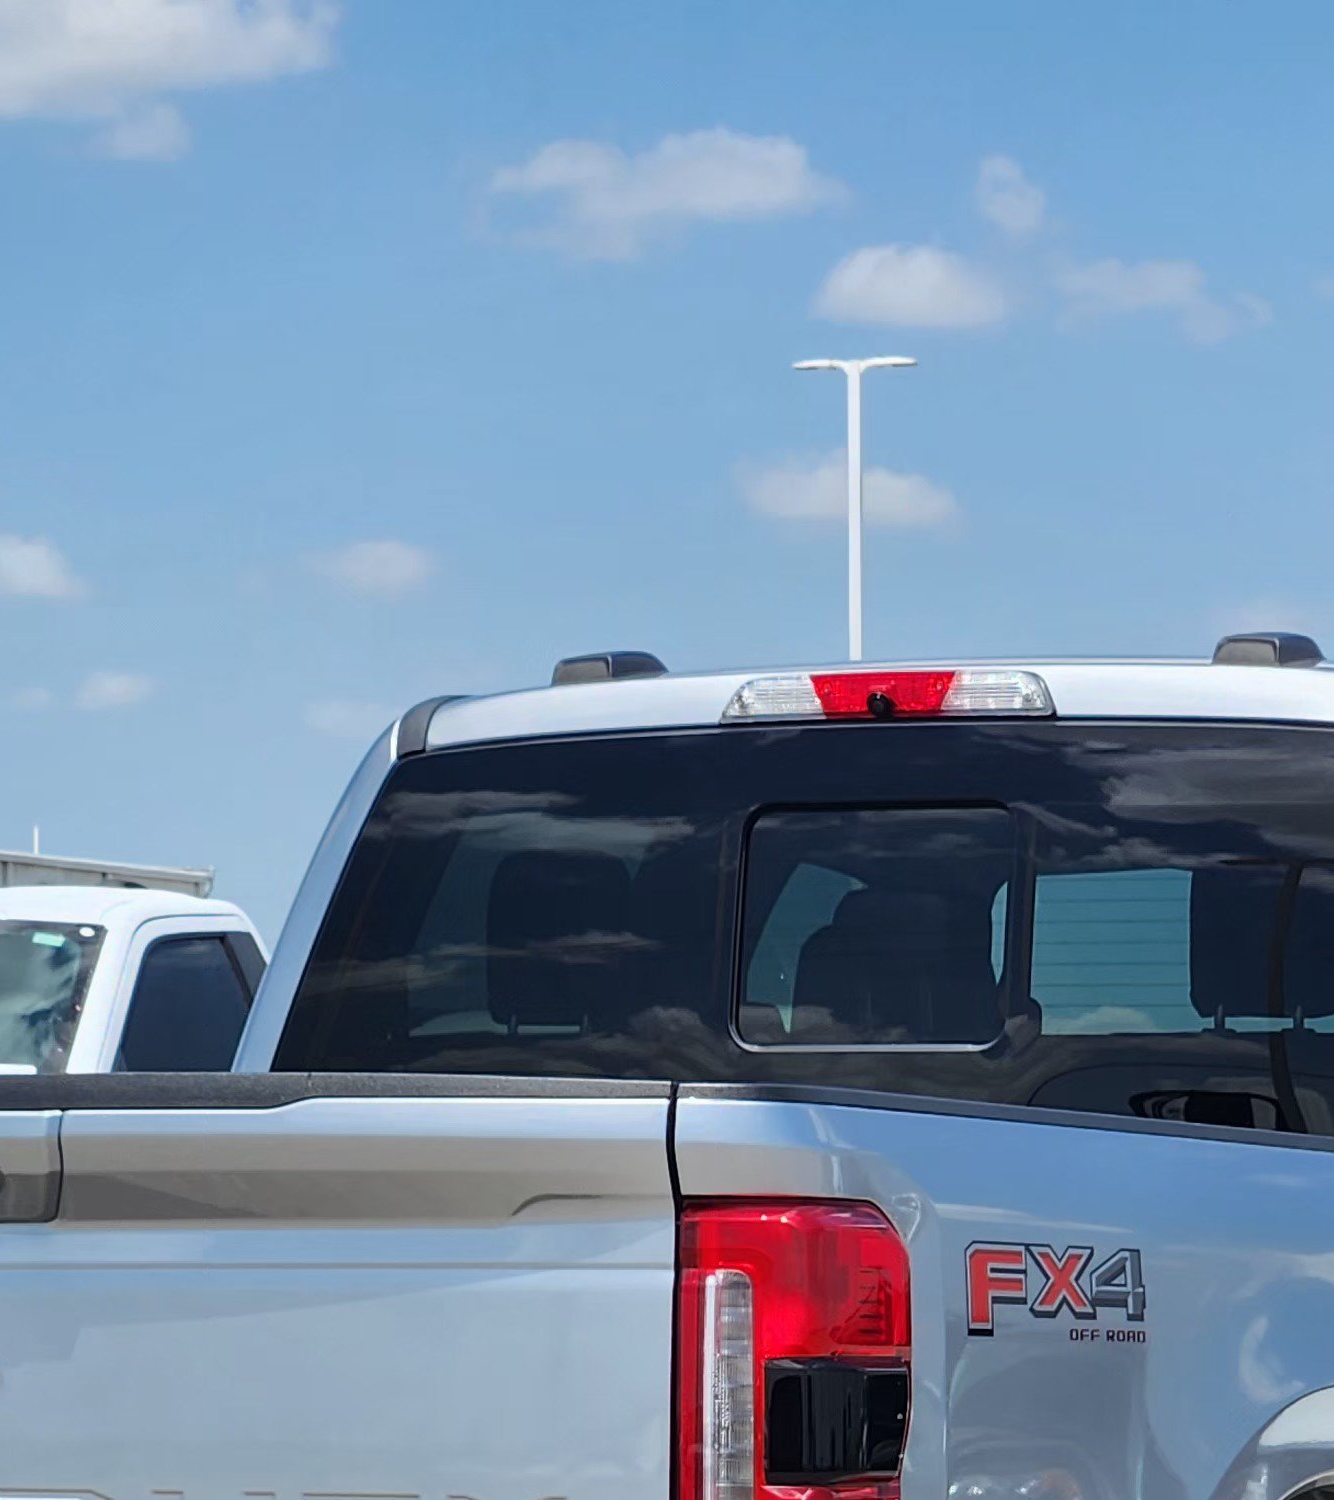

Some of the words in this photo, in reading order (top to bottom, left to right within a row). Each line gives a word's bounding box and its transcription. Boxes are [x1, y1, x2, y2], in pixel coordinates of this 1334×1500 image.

[965, 1240, 1146, 1337] FX4
[1069, 1328, 1100, 1342] OFF
[1106, 1329, 1146, 1343] ROAD
